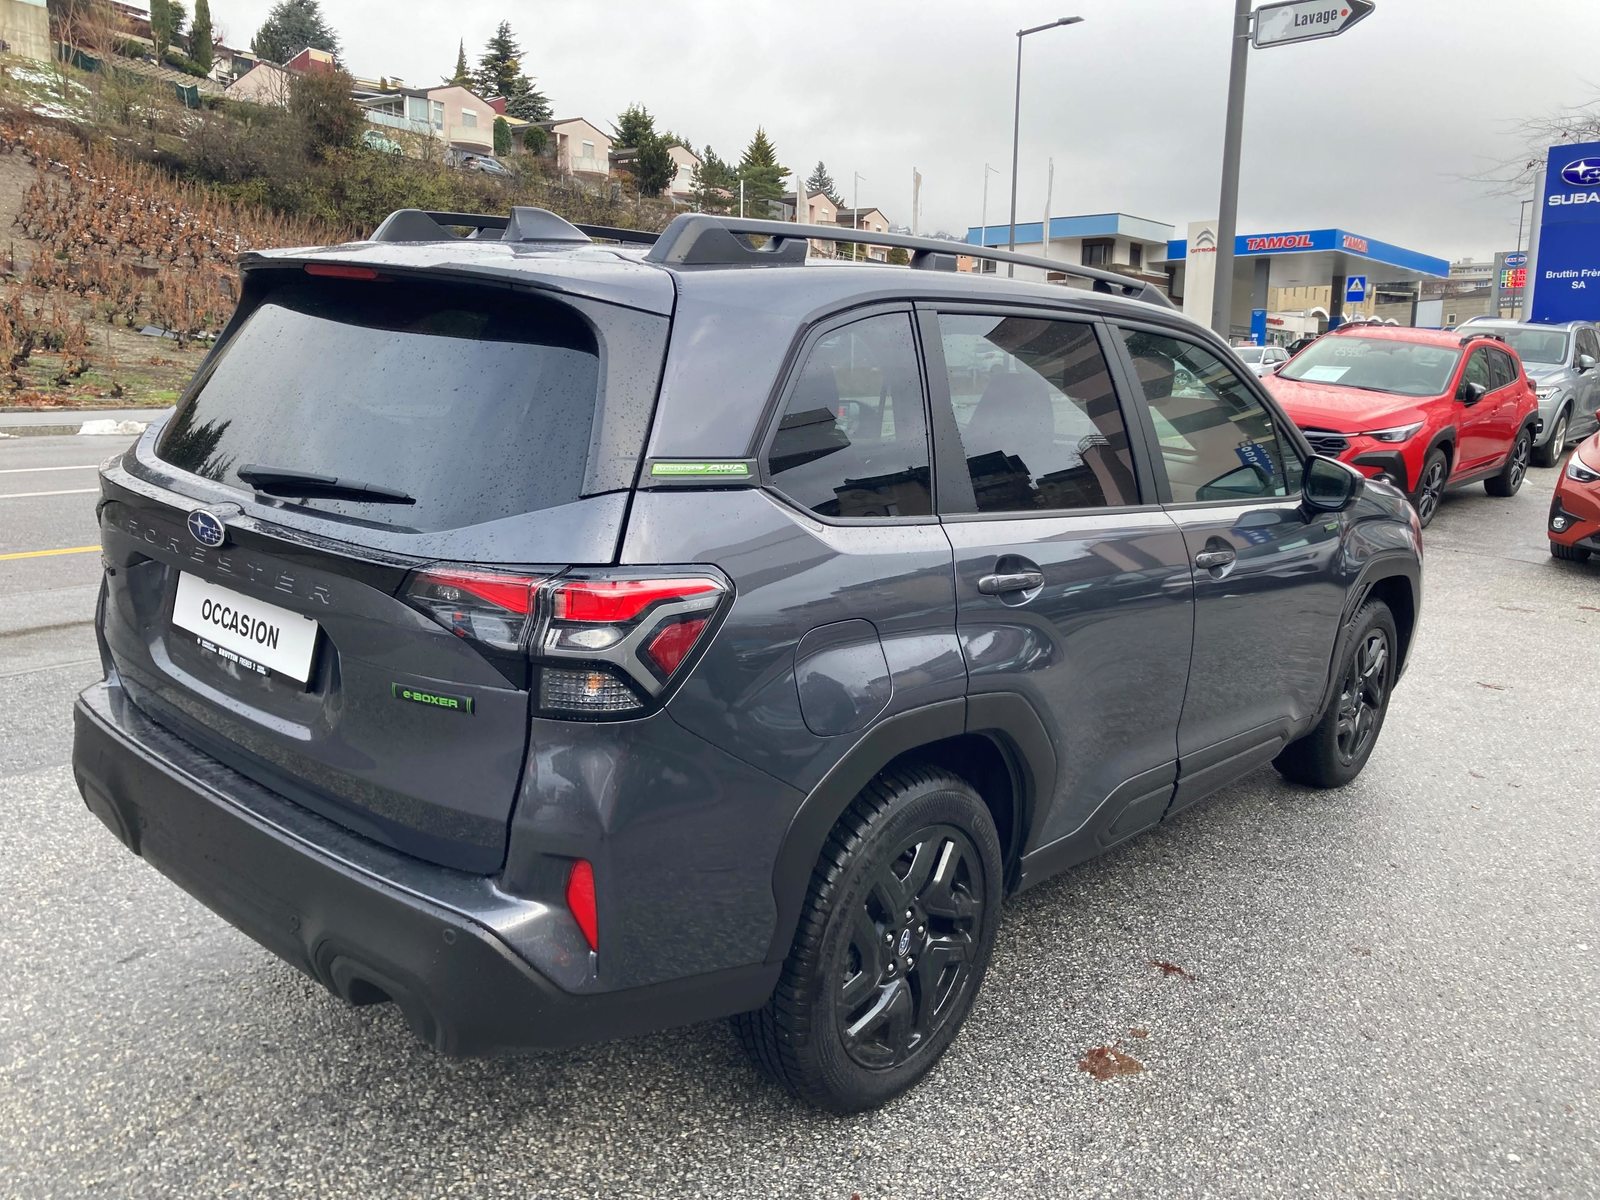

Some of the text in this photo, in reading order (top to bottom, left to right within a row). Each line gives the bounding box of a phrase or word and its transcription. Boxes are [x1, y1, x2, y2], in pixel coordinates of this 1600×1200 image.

[1295, 9, 1337, 26] Lavage
[1548, 192, 1600, 206] SUBA
[1190, 246, 1217, 254] CITROË
[1246, 234, 1313, 250] TAMOIL
[1343, 235, 1368, 253] TAMOIL
[1545, 268, 1600, 279] Bruttin Frèr
[1571, 281, 1586, 289] SA
[128, 519, 330, 604] FORESTER
[202, 599, 280, 650] OCCASION
[402, 690, 458, 708] e-BOXER
